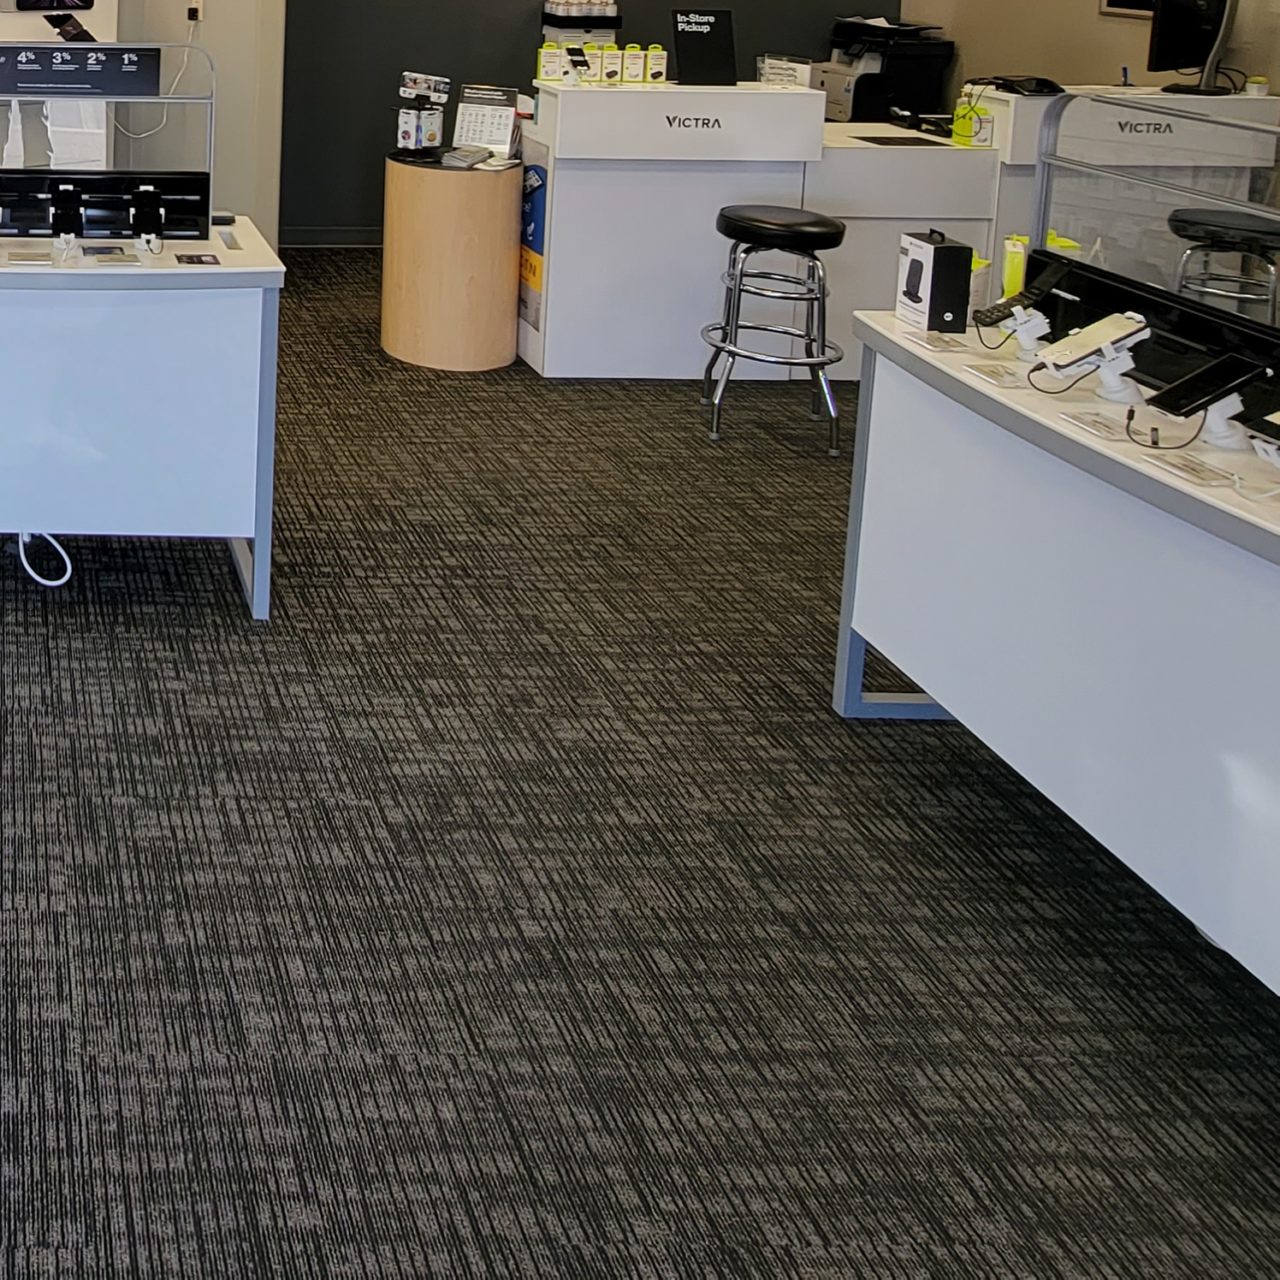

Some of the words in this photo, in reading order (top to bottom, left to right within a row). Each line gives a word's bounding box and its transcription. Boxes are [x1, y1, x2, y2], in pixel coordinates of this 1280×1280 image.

[677, 13, 715, 22] In-Store
[678, 23, 711, 33] Pickup
[17, 51, 36, 63] 4%
[52, 51, 72, 64] 3%
[86, 52, 107, 64] 2%
[121, 53, 138, 64] 1%
[665, 115, 722, 128] VICTRA
[1118, 120, 1174, 133] VICTRA
